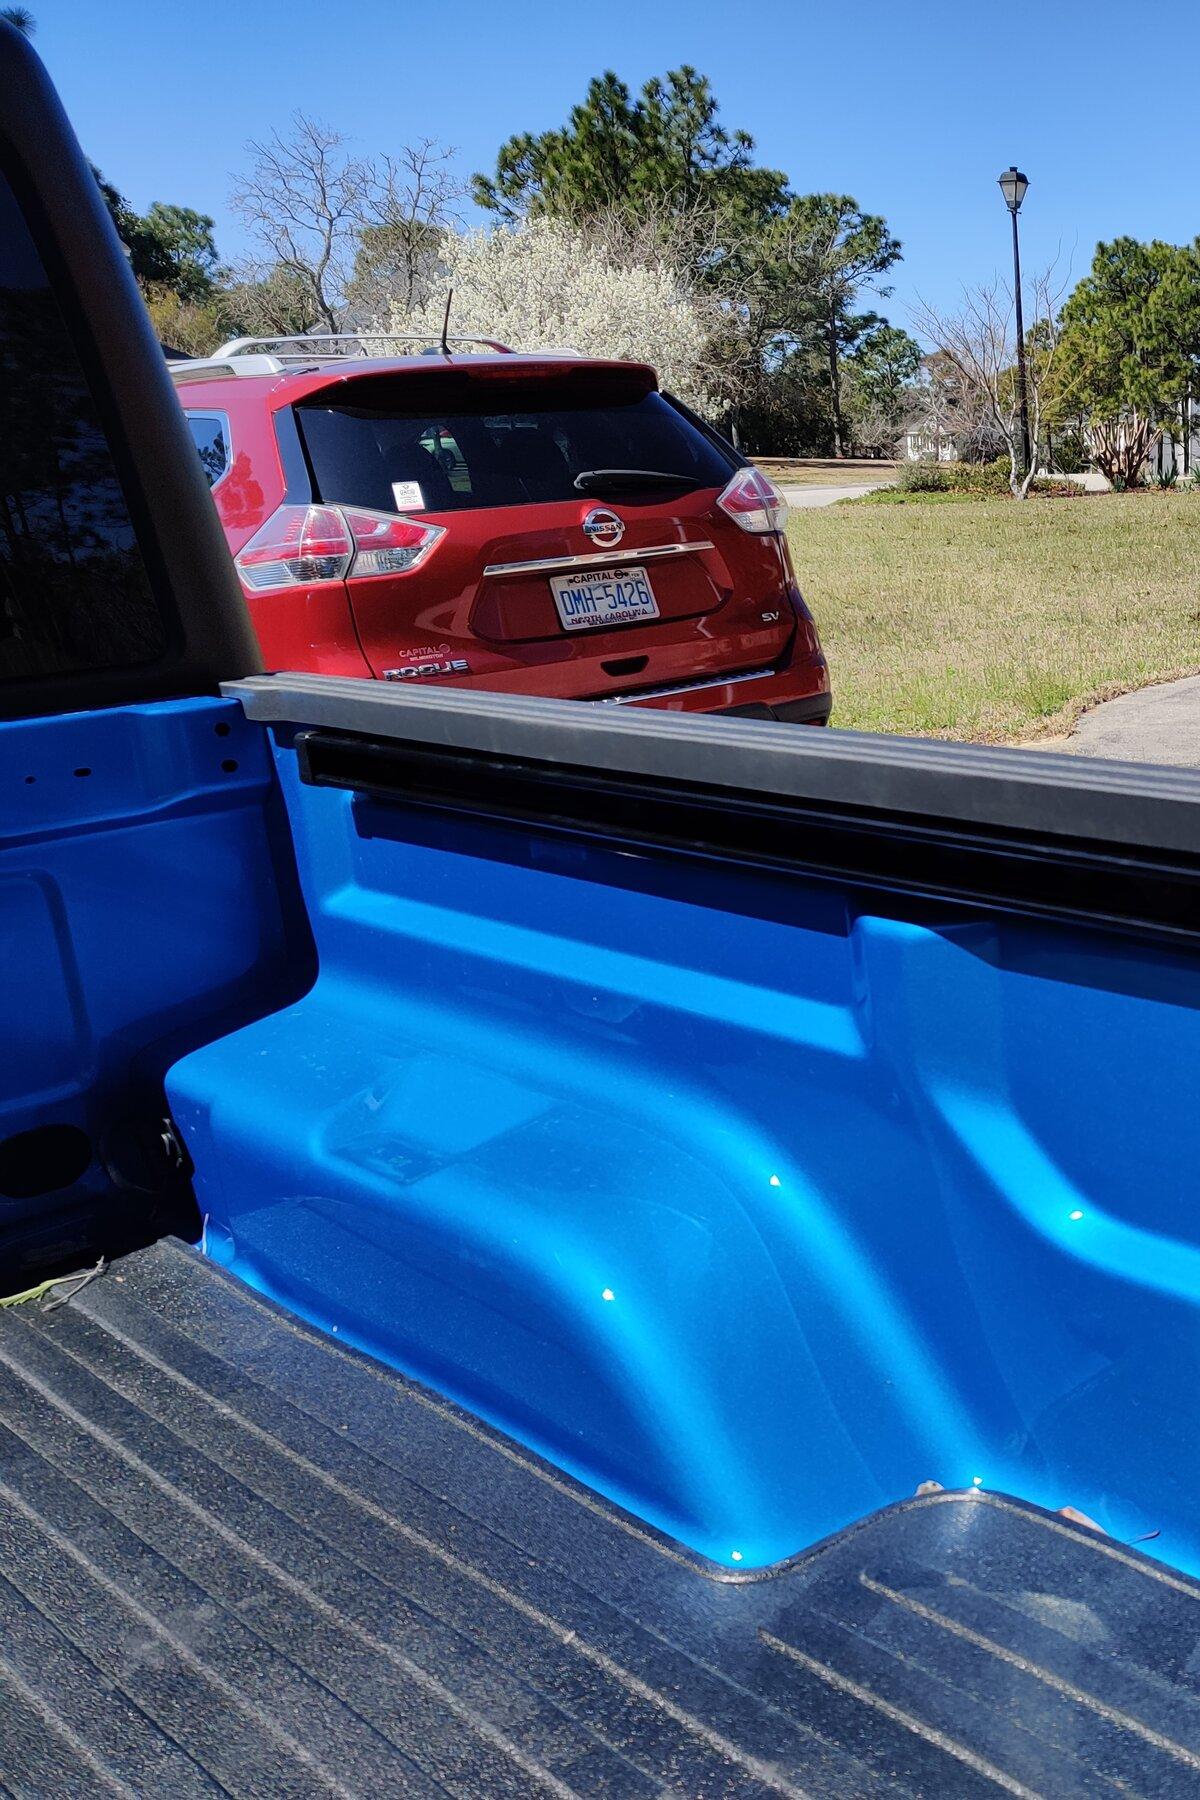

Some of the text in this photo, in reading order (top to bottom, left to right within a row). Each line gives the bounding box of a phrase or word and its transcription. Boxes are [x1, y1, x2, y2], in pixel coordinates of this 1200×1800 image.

[589, 522, 623, 532] NISSAN
[573, 572, 614, 584] CAPITAL
[560, 580, 650, 616] DMH-5426
[761, 611, 779, 621] SV
[399, 646, 440, 658] CAPITAL
[382, 659, 469, 681] ROGUE
